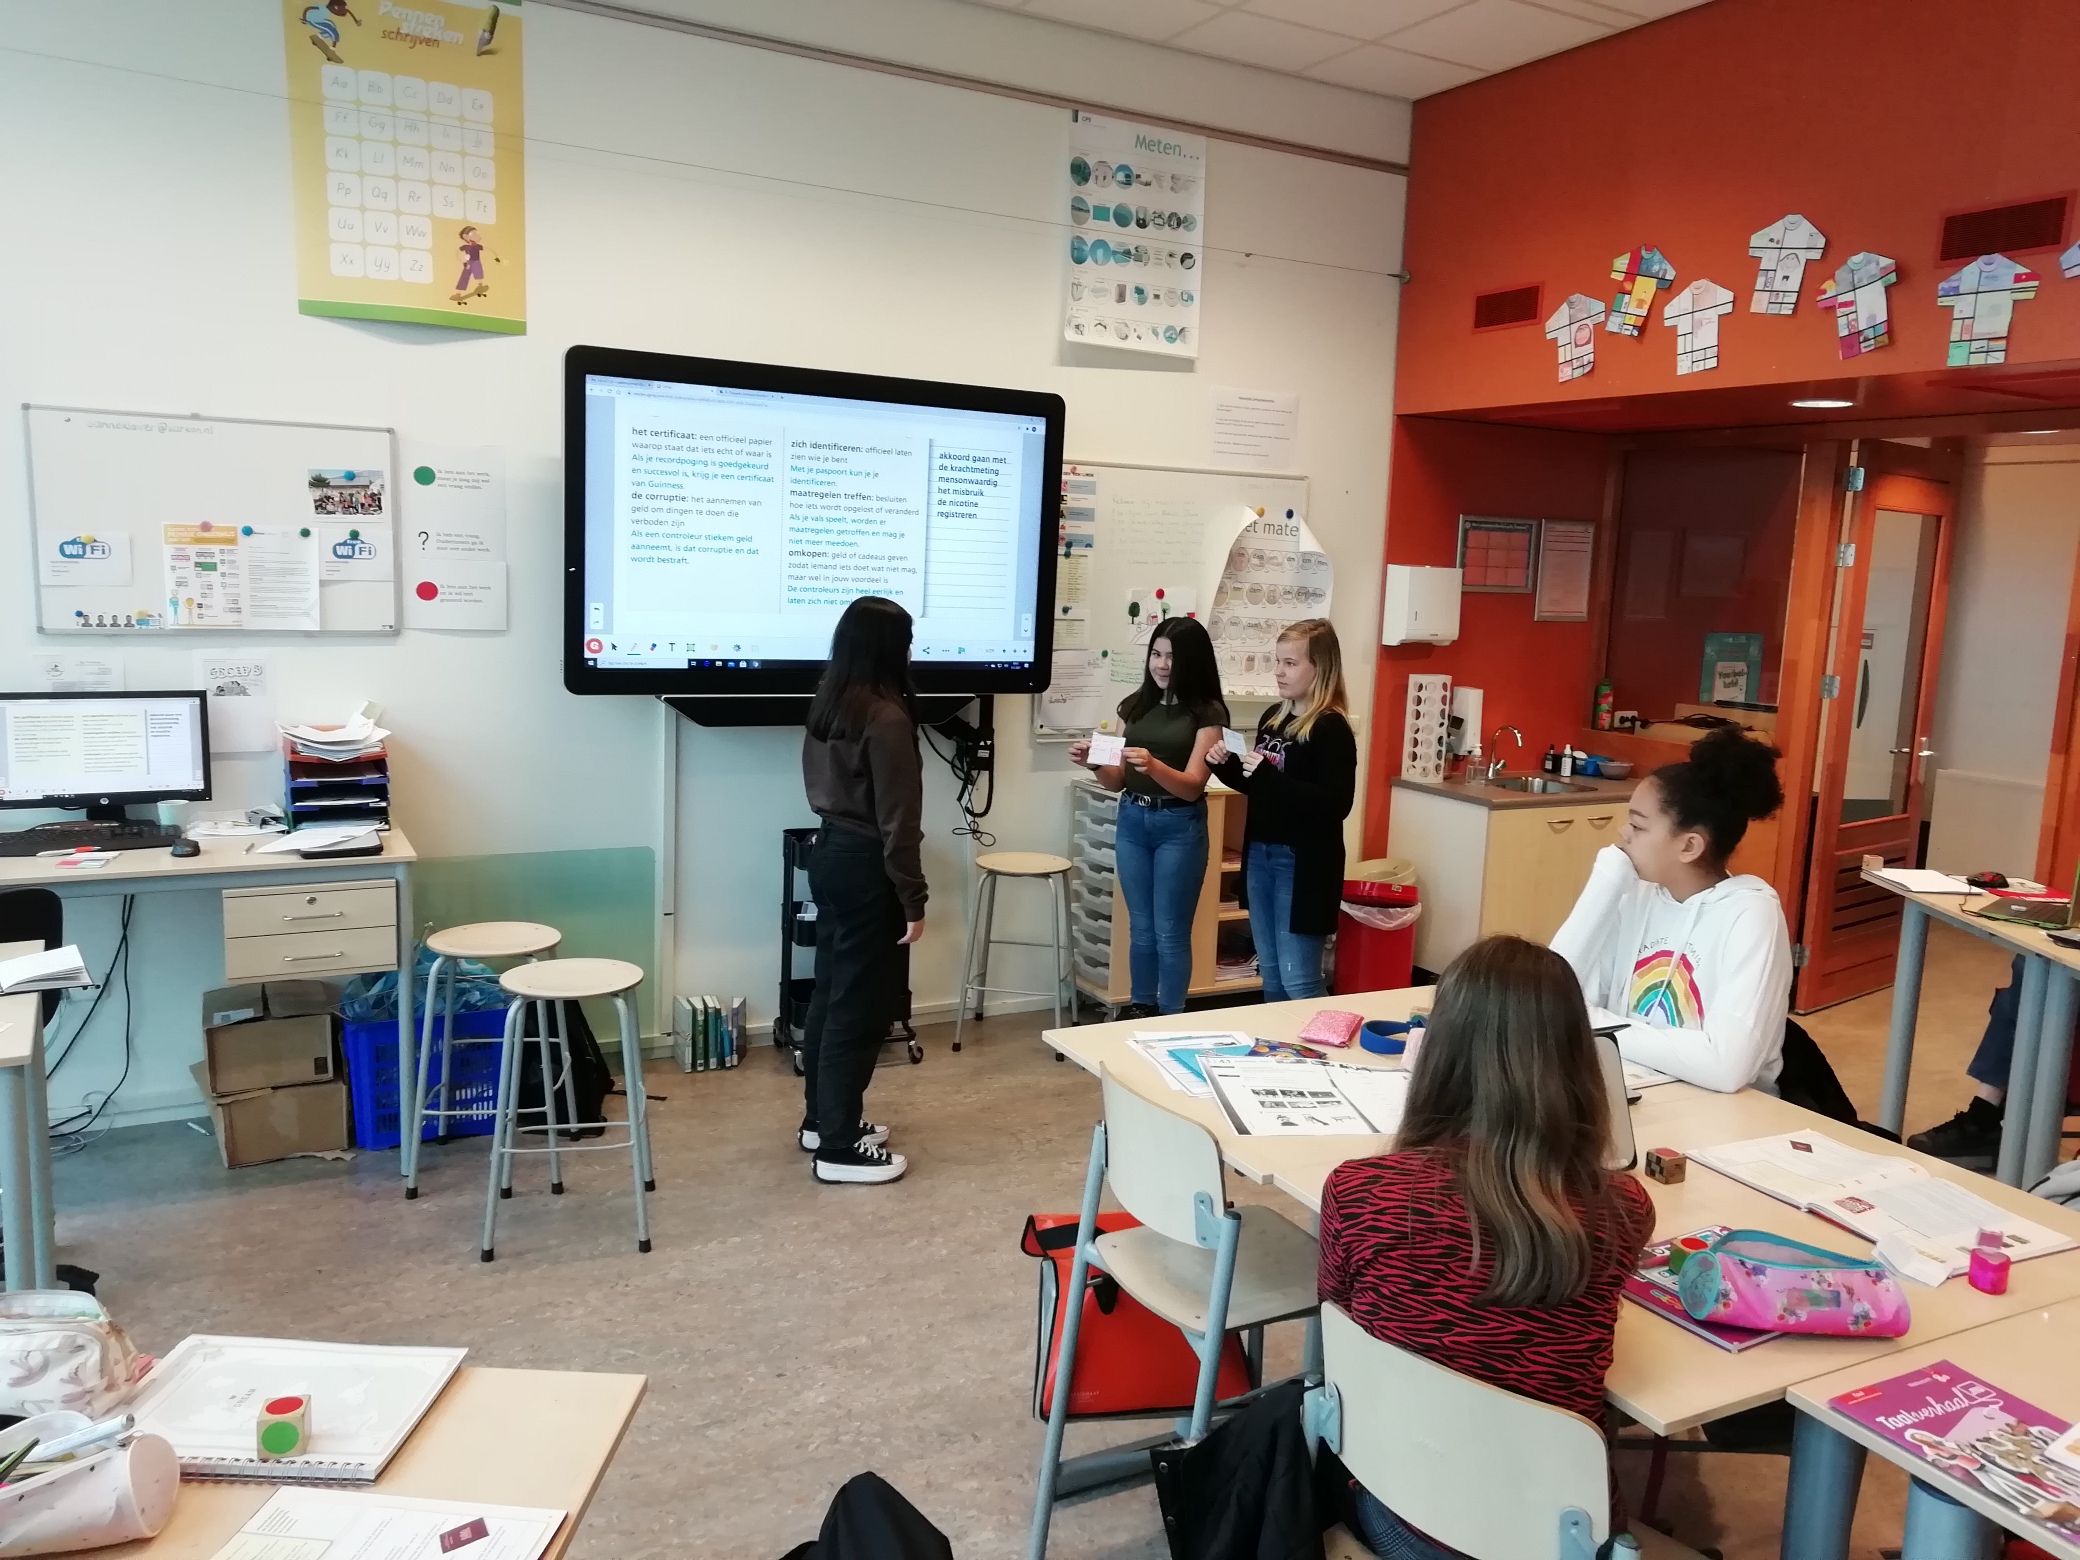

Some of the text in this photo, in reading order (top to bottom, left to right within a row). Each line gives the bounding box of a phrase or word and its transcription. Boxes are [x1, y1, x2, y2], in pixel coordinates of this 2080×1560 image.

[632, 427, 647, 437] het
[650, 429, 697, 439] certificaat:
[716, 434, 746, 443] officieel
[749, 437, 772, 446] papier
[632, 443, 662, 451] waarop
[686, 445, 699, 453] dat
[791, 440, 807, 448] zich
[810, 441, 863, 452] identificeren:
[865, 447, 893, 455] officieel
[939, 452, 970, 461] akkoord
[972, 455, 990, 463] gaan
[656, 456, 708, 467] recordpoging
[718, 460, 768, 470] goedgekeurd
[644, 468, 679, 476] succesvol
[692, 470, 709, 480] krijg
[737, 472, 774, 482] certificaat
[951, 464, 999, 476] krachtmeting
[790, 477, 837, 486] identificeren.
[938, 476, 998, 487] mensonwaardig
[790, 490, 841, 499] maatregelen
[844, 492, 874, 501] treffen:
[938, 486, 984, 496] het misbruik
[632, 491, 642, 499] de
[646, 493, 688, 502] corruptie:
[706, 497, 746, 505] aannemen
[949, 499, 978, 507] nicotine
[631, 505, 648, 513] geld
[666, 507, 693, 516] dingen
[844, 504, 873, 513] opgelost
[937, 510, 977, 519] registreren
[631, 518, 685, 528] verboden zijn
[789, 526, 834, 535] maatregelen
[837, 528, 870, 536] getroffen
[662, 532, 702, 540] controleur
[705, 533, 734, 541] stiekem
[789, 550, 829, 558] omkopen:
[657, 556, 689, 564] bestraft.
[832, 575, 849, 583] jouw
[842, 587, 853, 595] zijn
